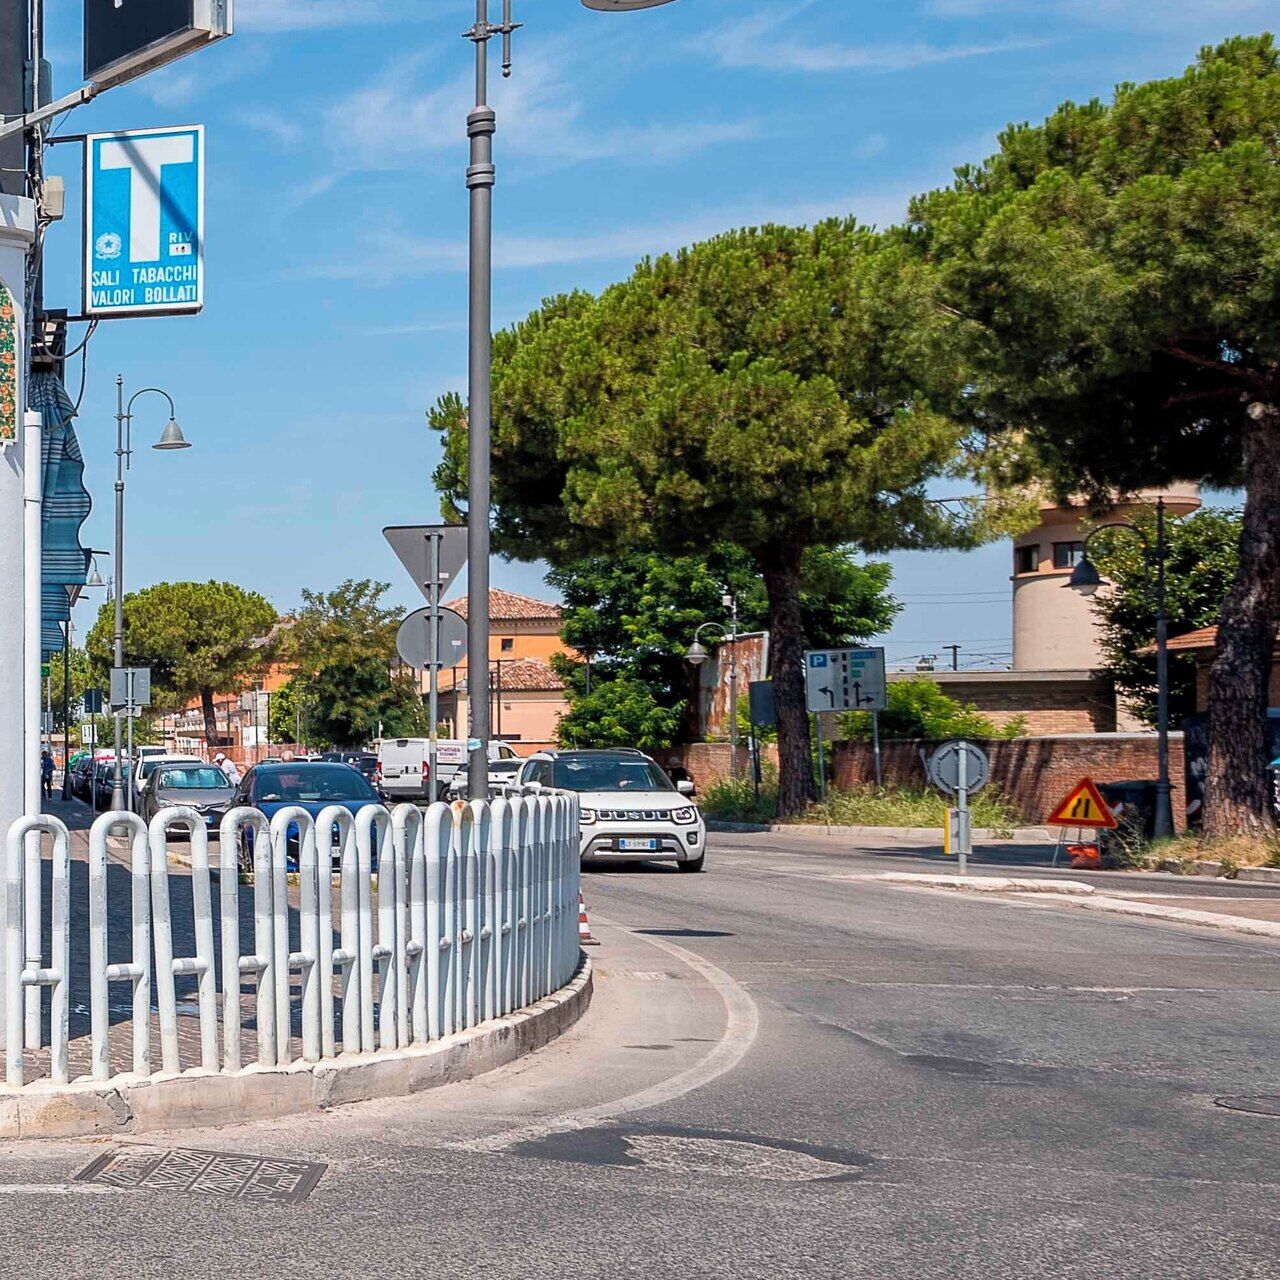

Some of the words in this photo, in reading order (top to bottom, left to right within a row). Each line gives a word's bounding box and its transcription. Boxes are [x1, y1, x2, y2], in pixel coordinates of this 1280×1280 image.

[100, 134, 194, 263] T
[92, 270, 120, 287] SALI
[132, 265, 197, 284] TABACCHI
[92, 288, 134, 306] VALORI
[145, 285, 197, 303] BOLLATI
